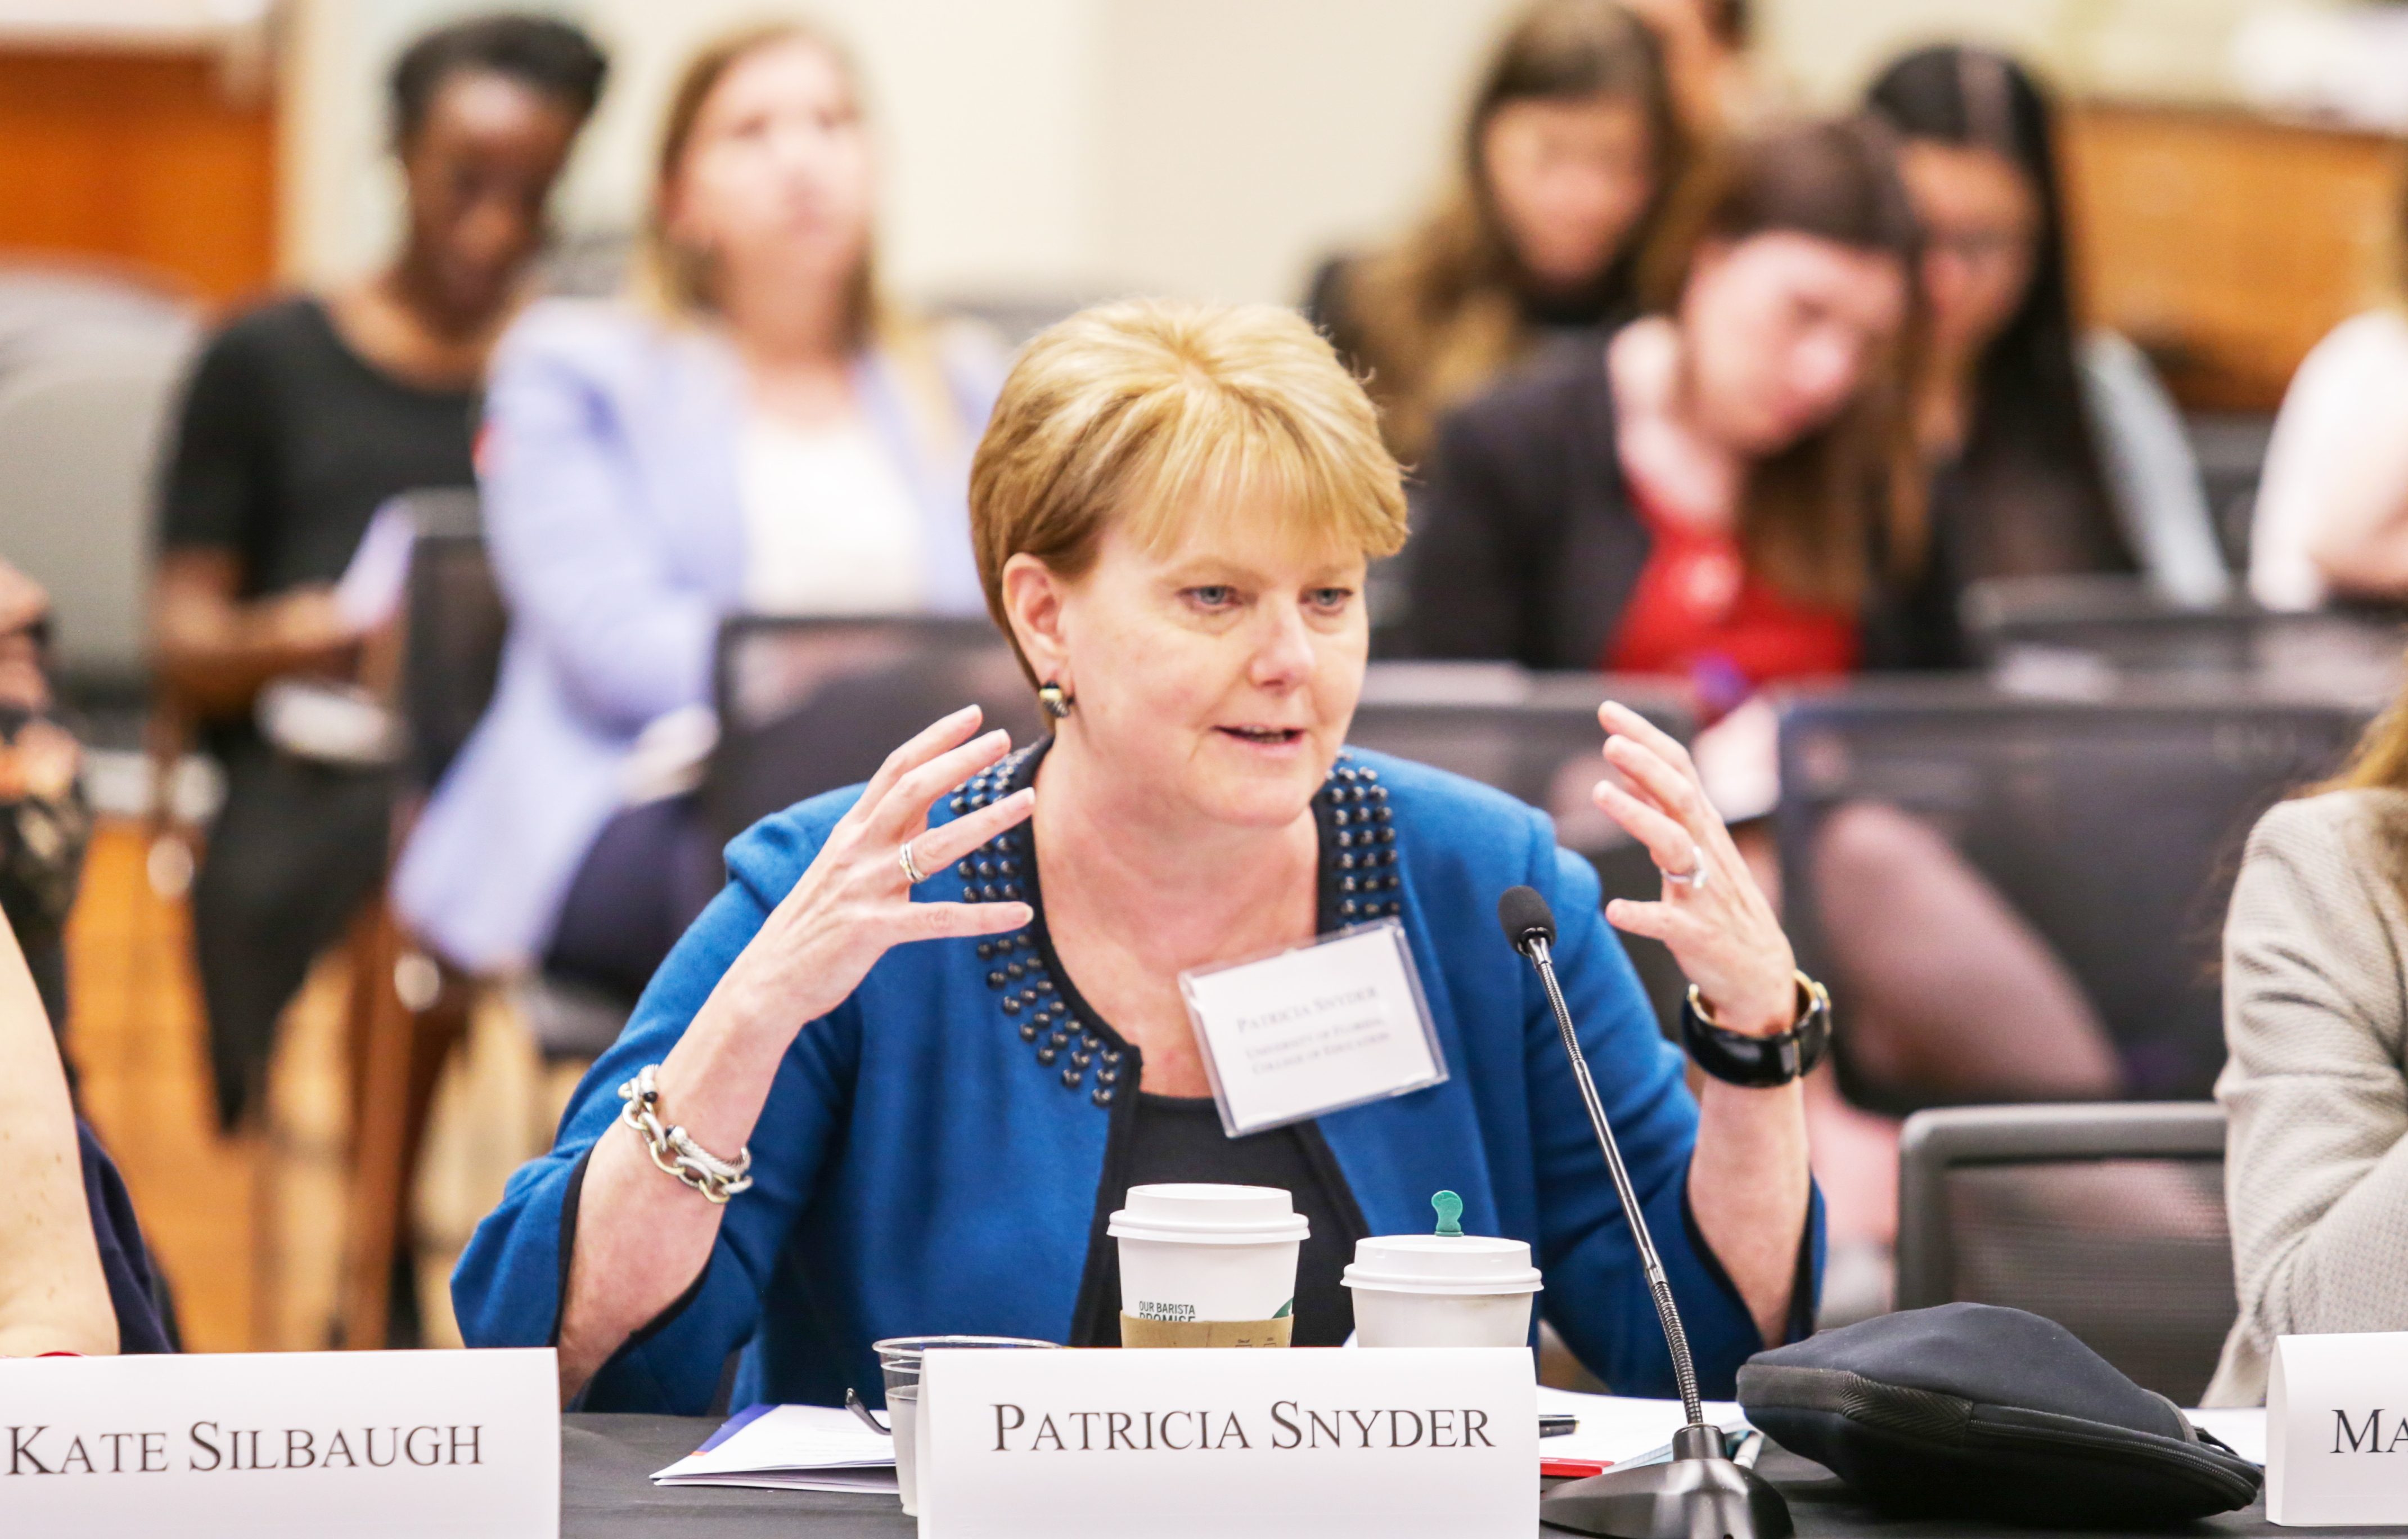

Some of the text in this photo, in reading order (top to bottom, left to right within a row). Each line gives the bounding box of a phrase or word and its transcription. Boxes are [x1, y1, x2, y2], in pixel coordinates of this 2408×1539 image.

[1139, 1301, 1195, 1315] OUR BARISTA
[3, 1420, 484, 1475] KATE SILBAUGH
[991, 1401, 1496, 1451] PATRICIA SNYDER
